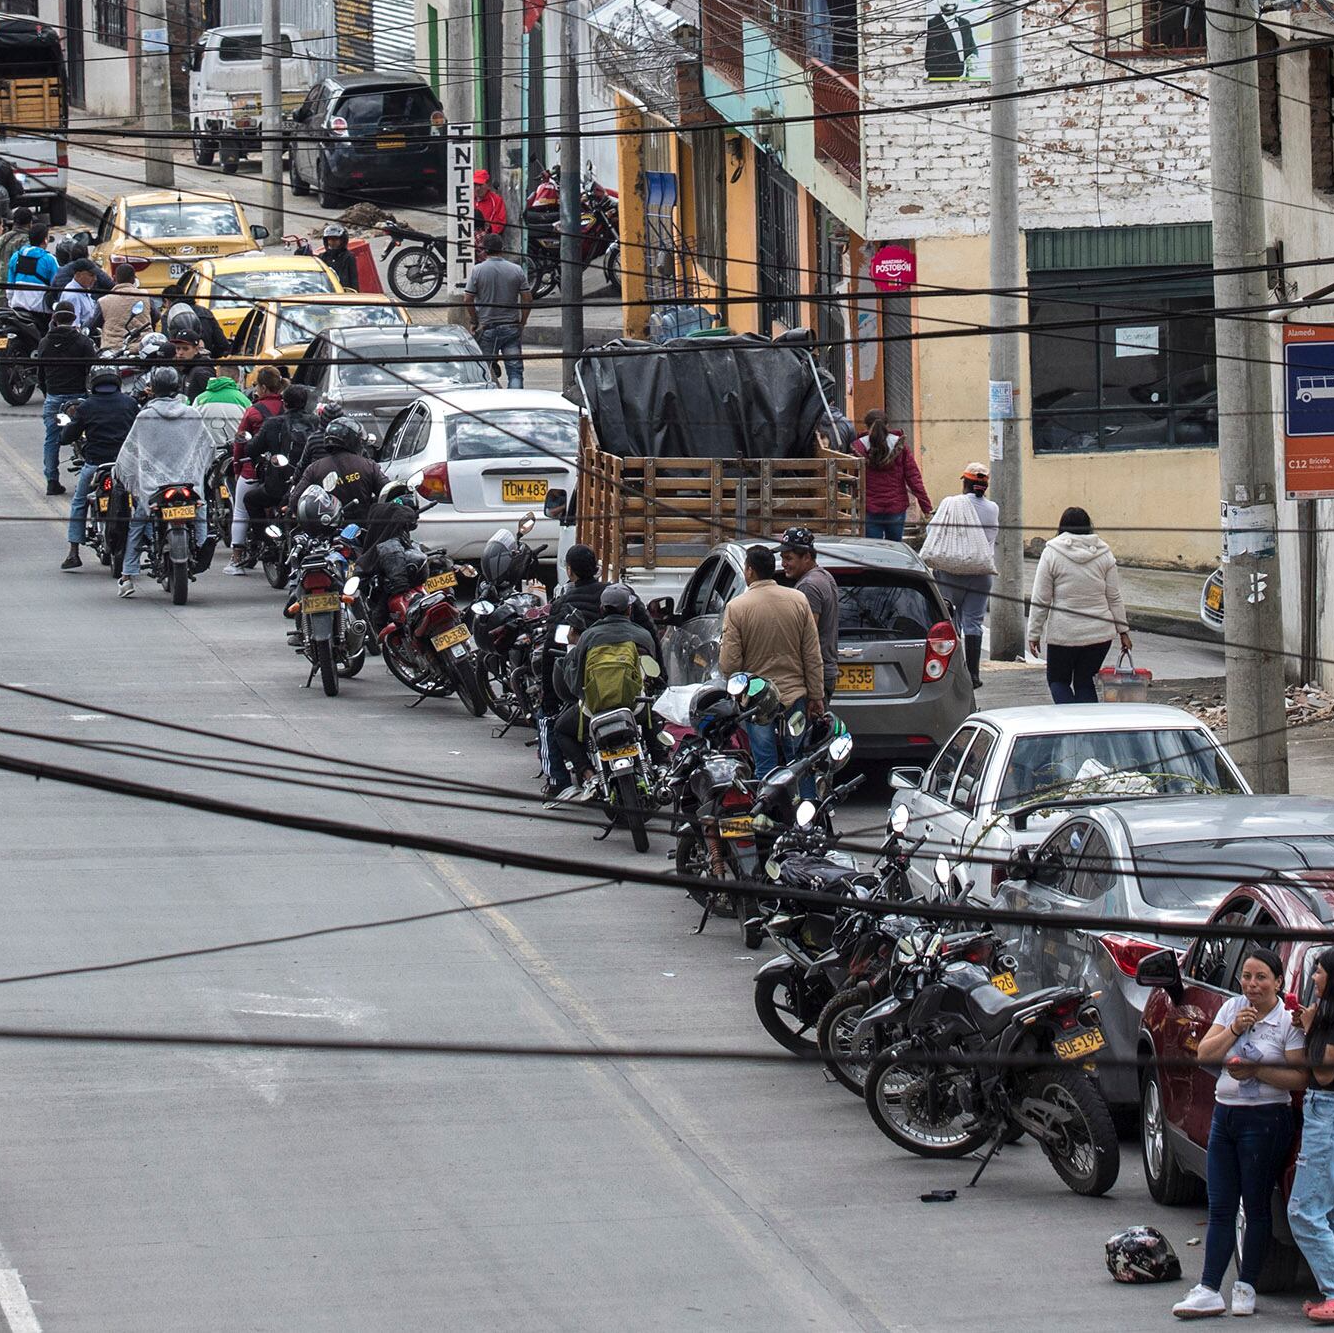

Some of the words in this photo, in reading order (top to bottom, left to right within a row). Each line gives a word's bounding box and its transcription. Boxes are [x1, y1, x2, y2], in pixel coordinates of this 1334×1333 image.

[451, 125, 473, 279] INTERNET
[1288, 329, 1315, 337] Alameda
[1288, 460, 1307, 469] C12
[345, 473, 361, 484] SEG
